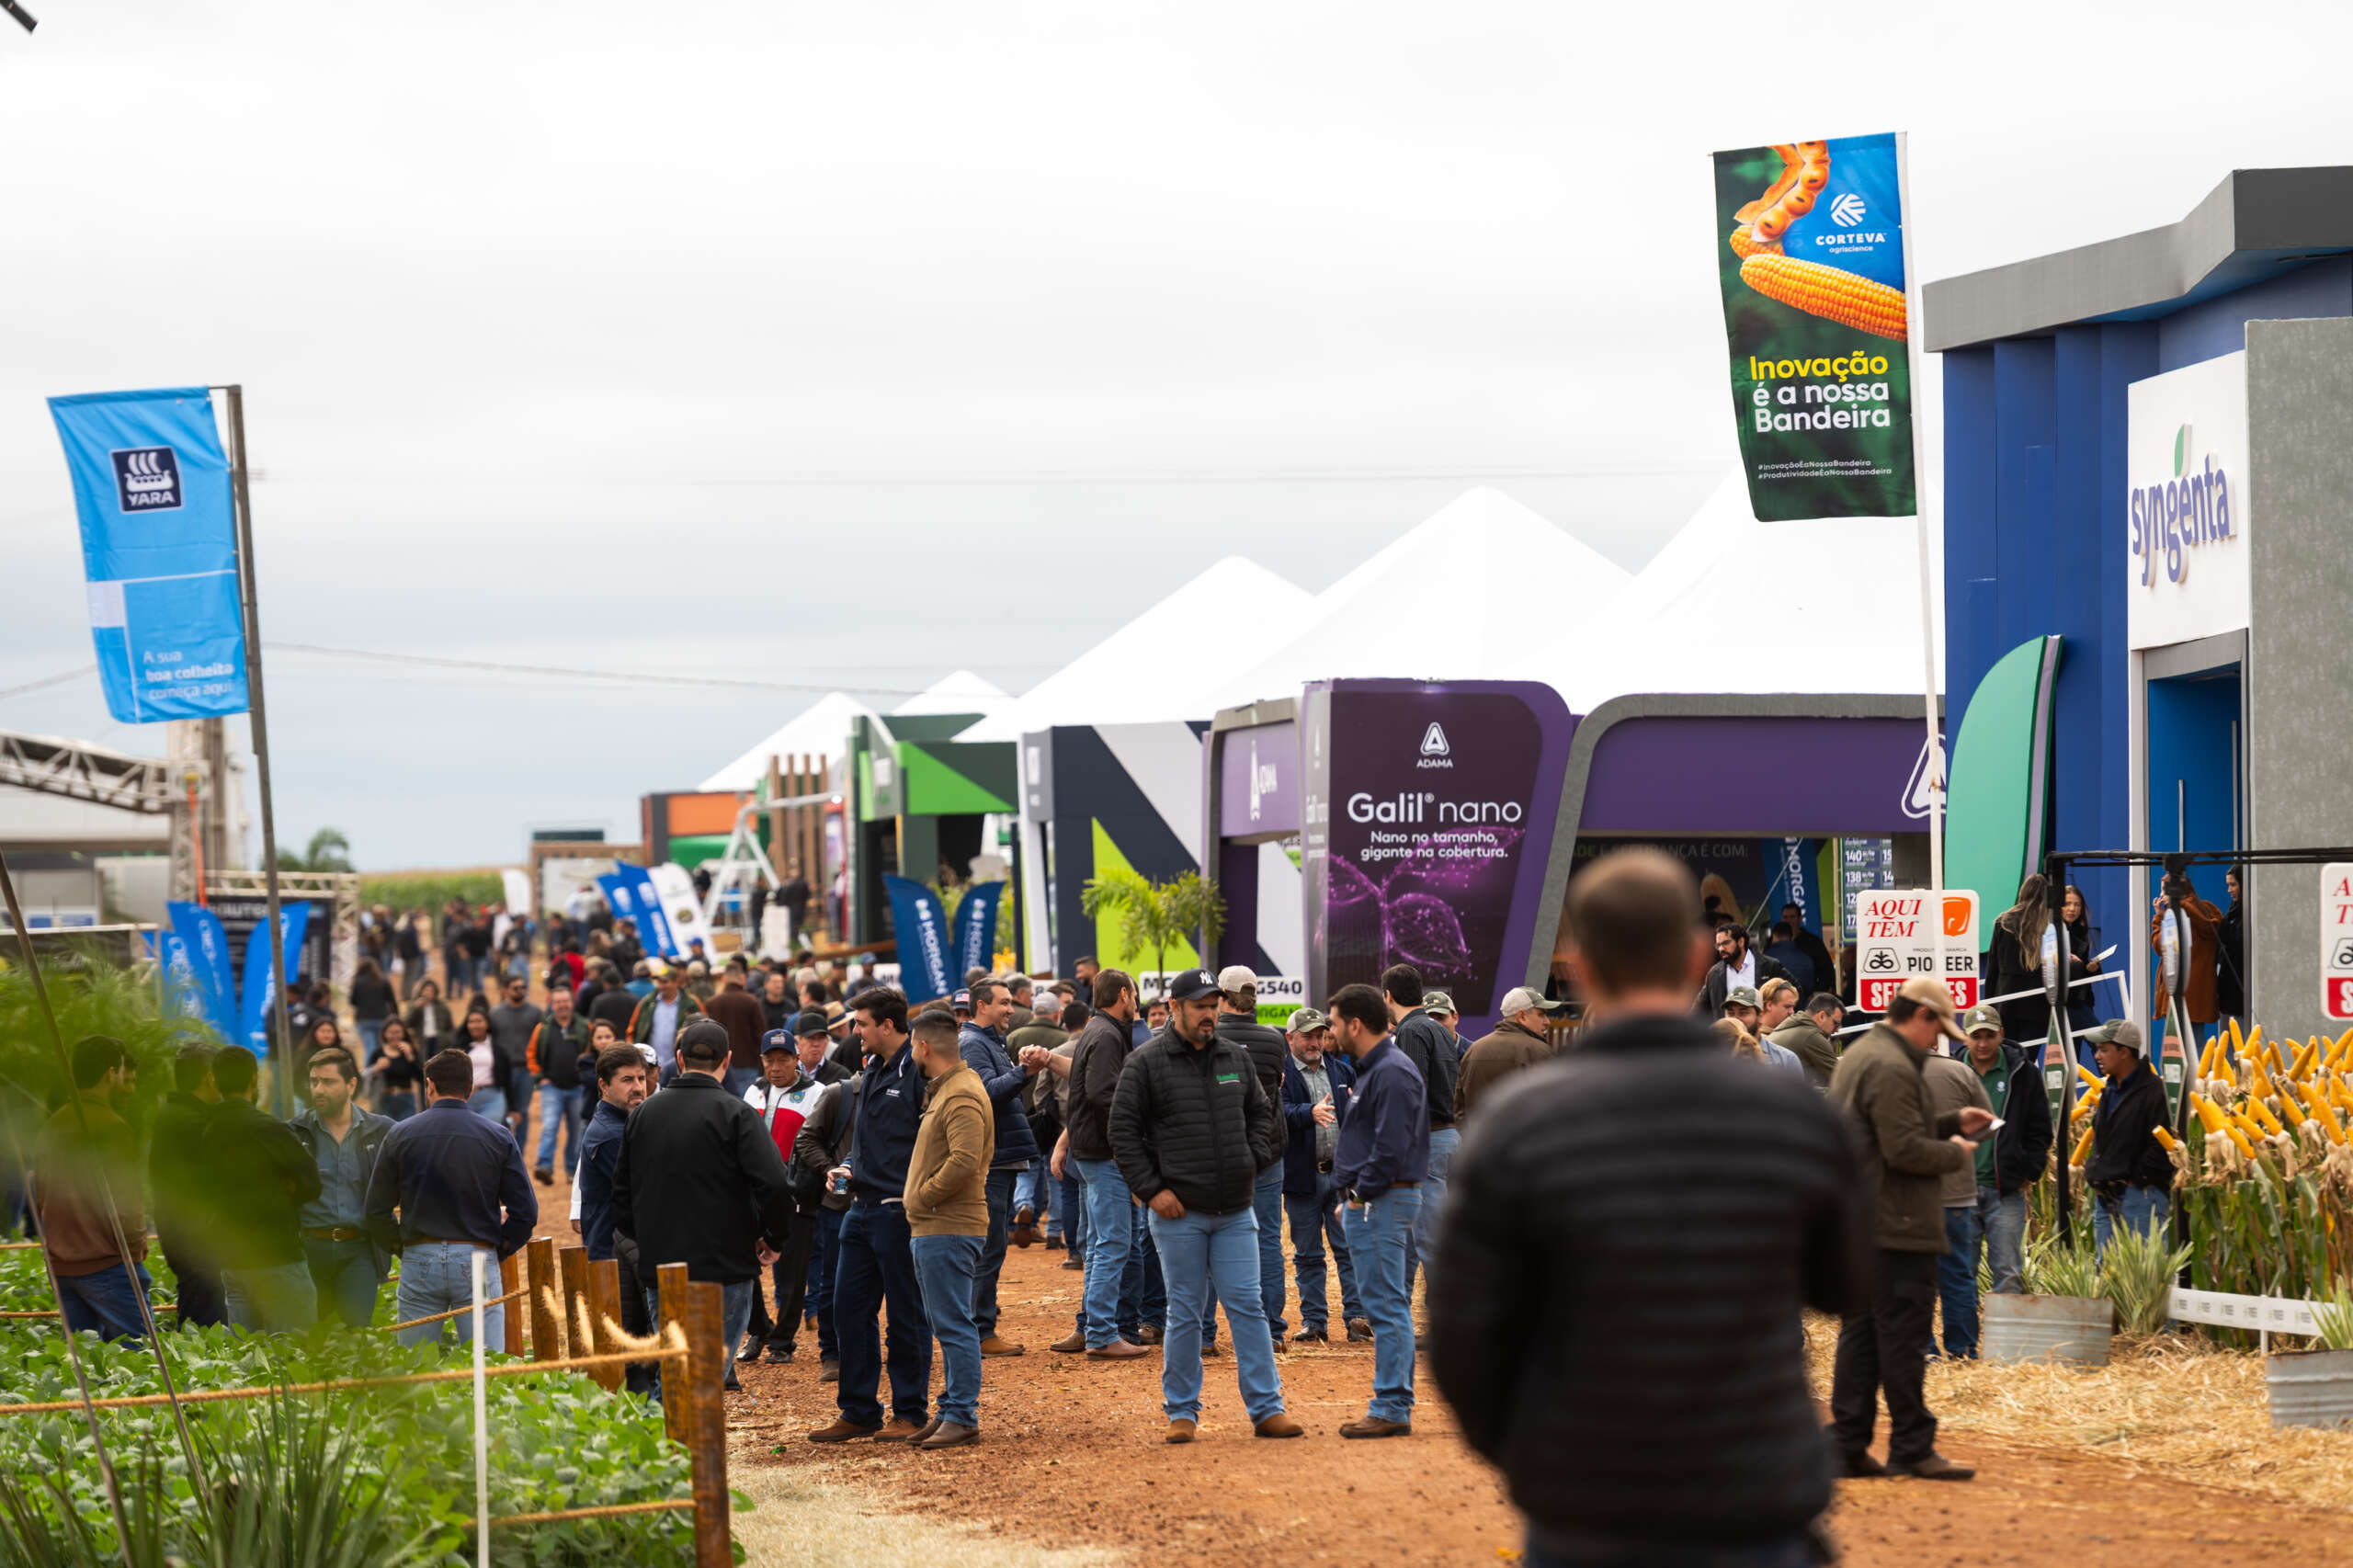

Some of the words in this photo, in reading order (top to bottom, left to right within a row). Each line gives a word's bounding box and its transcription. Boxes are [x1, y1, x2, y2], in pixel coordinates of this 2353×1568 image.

[1815, 233, 1886, 246] CORTEVA
[1829, 244, 1873, 254] agriscience
[1749, 350, 1889, 382] Inovação
[1753, 381, 1770, 406] é
[1777, 385, 1797, 405] a
[1804, 382, 1890, 403] nossa
[1755, 403, 1891, 433] Bandeira
[127, 490, 176, 506] YARA
[2131, 453, 2231, 587] syngenta
[143, 650, 155, 664] A
[156, 651, 183, 663] sua
[145, 669, 173, 682] boa
[175, 662, 234, 678] colheita
[148, 686, 200, 699] começa
[203, 679, 233, 696] aqui
[1416, 758, 1453, 768] ADAMA
[1438, 801, 1522, 823] nano
[1370, 831, 1408, 844] Nano
[1411, 834, 1429, 844] no
[1433, 830, 1498, 845] tamanho,
[1360, 846, 1414, 861] gigante
[1416, 848, 1435, 858] na
[1438, 846, 1508, 858] cobertura.
[1864, 899, 1923, 920] AQUI
[1906, 956, 1973, 971] PIOEER
[1256, 981, 1302, 995] G540
